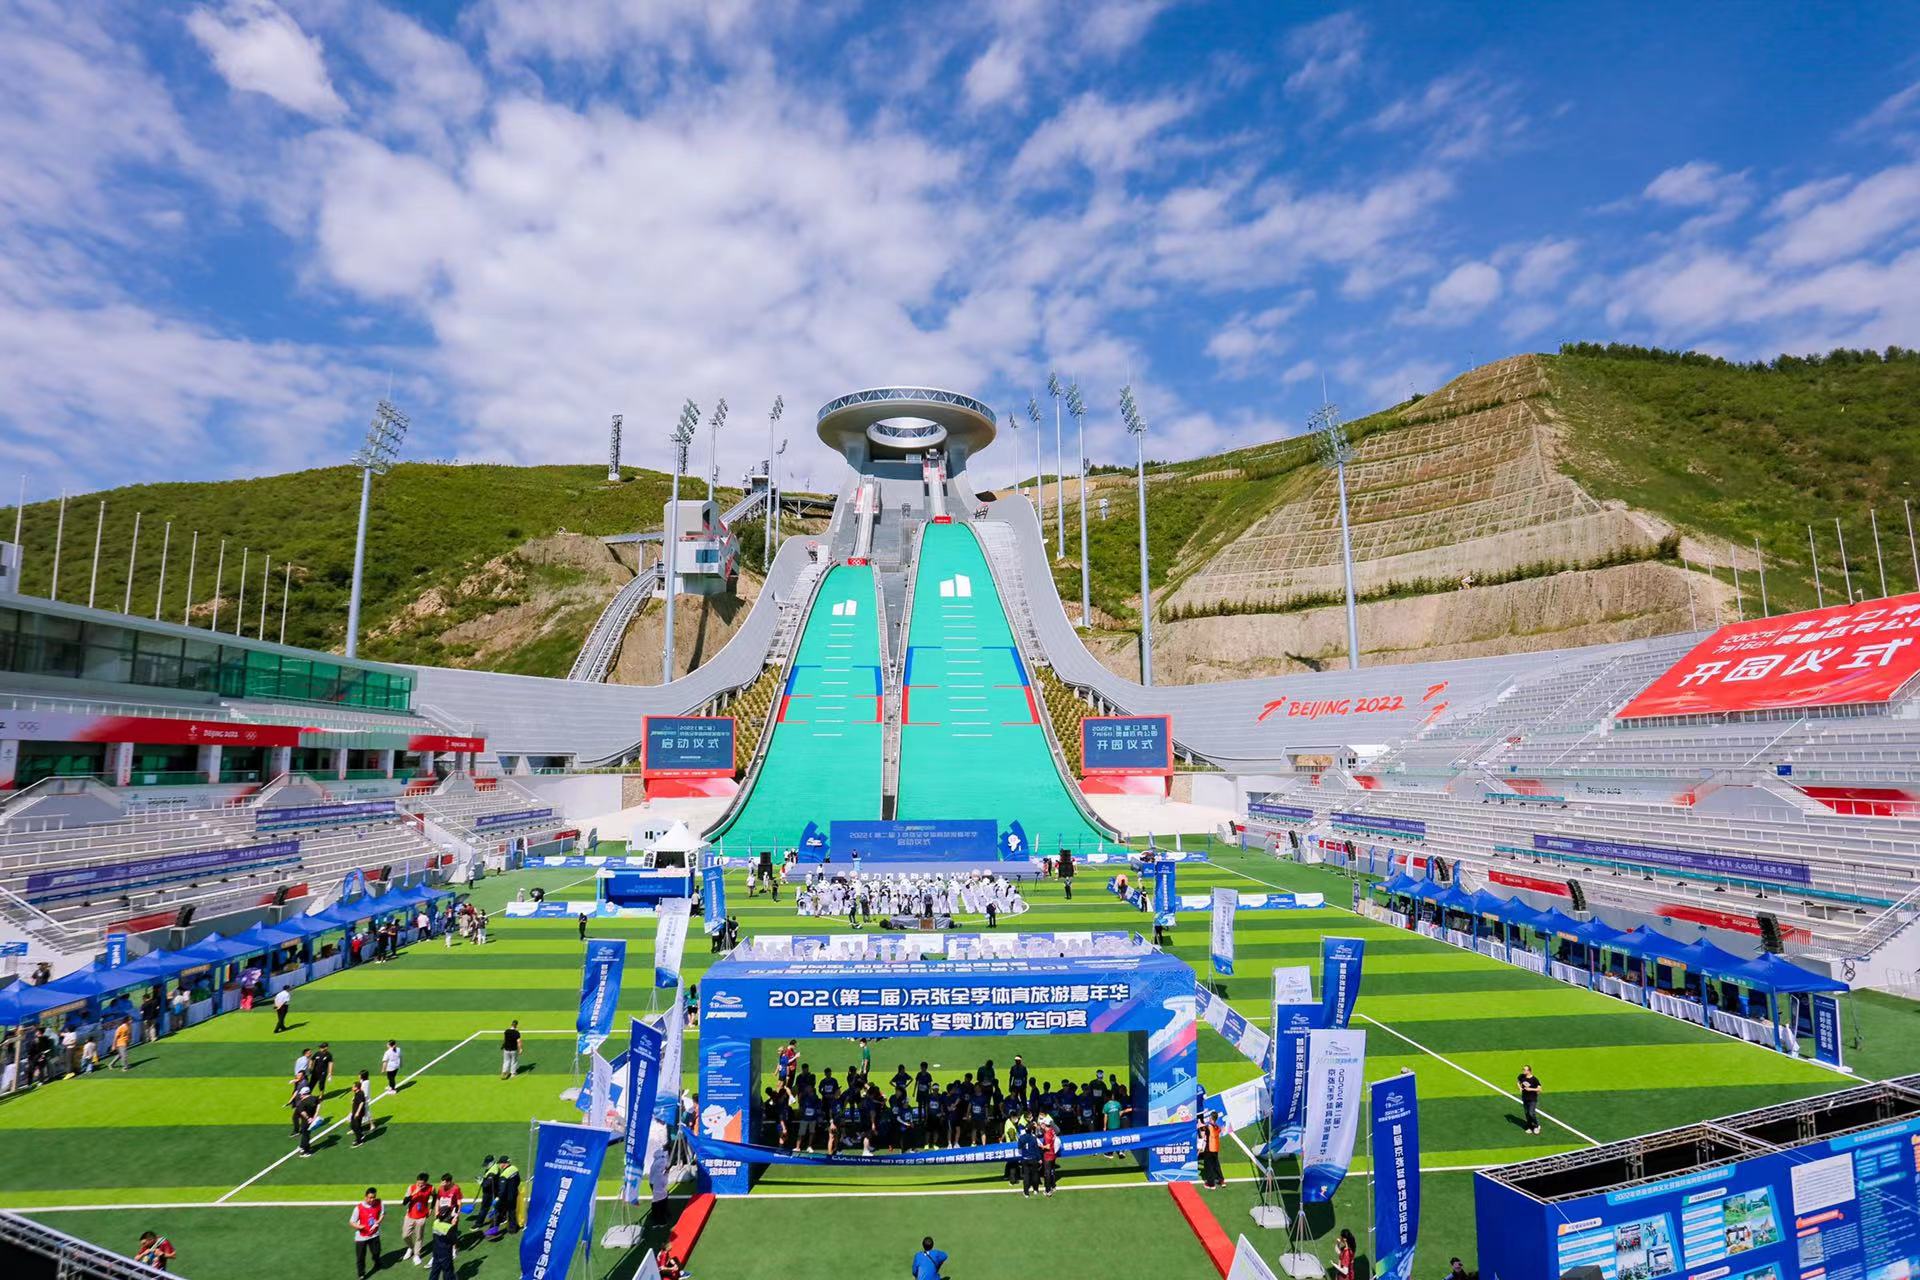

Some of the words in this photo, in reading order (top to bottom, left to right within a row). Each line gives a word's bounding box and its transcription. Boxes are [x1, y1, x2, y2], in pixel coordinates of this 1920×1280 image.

[1678, 637, 1914, 688] 开园仪式
[1288, 699, 1350, 719] BEIJING
[1354, 696, 1406, 713] 2022
[661, 737, 719, 749] 启动仪式
[1097, 739, 1153, 750] 开园仪式
